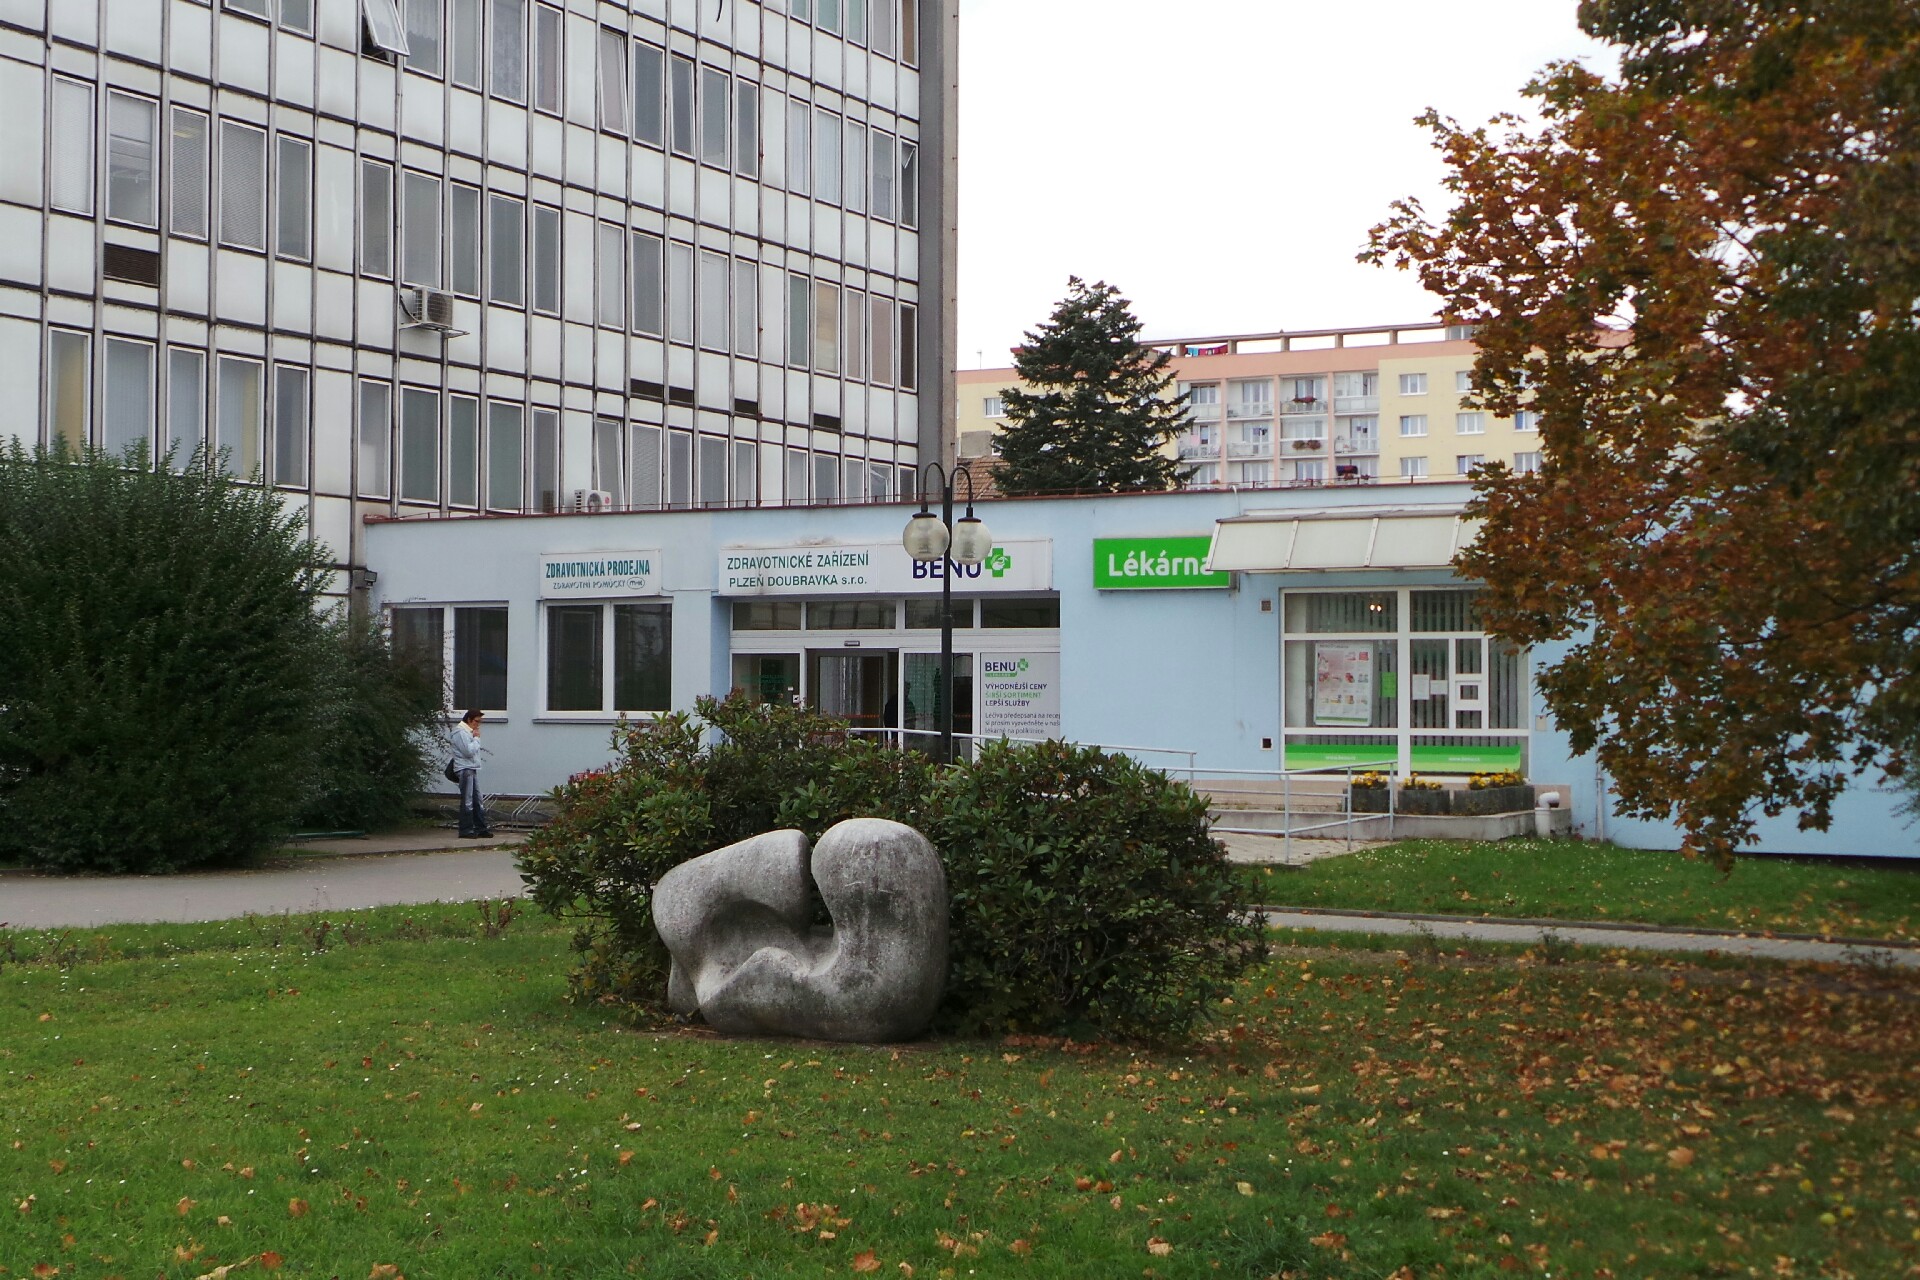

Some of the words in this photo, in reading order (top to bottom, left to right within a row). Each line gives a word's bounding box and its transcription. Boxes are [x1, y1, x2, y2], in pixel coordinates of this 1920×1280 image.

[728, 552, 813, 570] ZDRAVOTNICKÉ
[817, 550, 869, 568] ZAŘÍZENÍ
[1108, 549, 1214, 577] Lékárna
[545, 558, 606, 578] ZDRAVOTNICKÁ
[607, 560, 651, 576] PRODEJNA
[553, 580, 591, 590] ZDRAVOTNÍ
[593, 579, 626, 589] POMŮCKY
[729, 574, 764, 588] PLZEŇ
[768, 575, 838, 587] DOUBRAVKA
[841, 576, 867, 585] s.r.o.
[984, 661, 1016, 672] BENU
[984, 682, 1028, 690] VÝHODNĚJŠÍ
[985, 699, 1004, 707] LEPŠÍ
[1004, 699, 1031, 707] SLUŽBY
